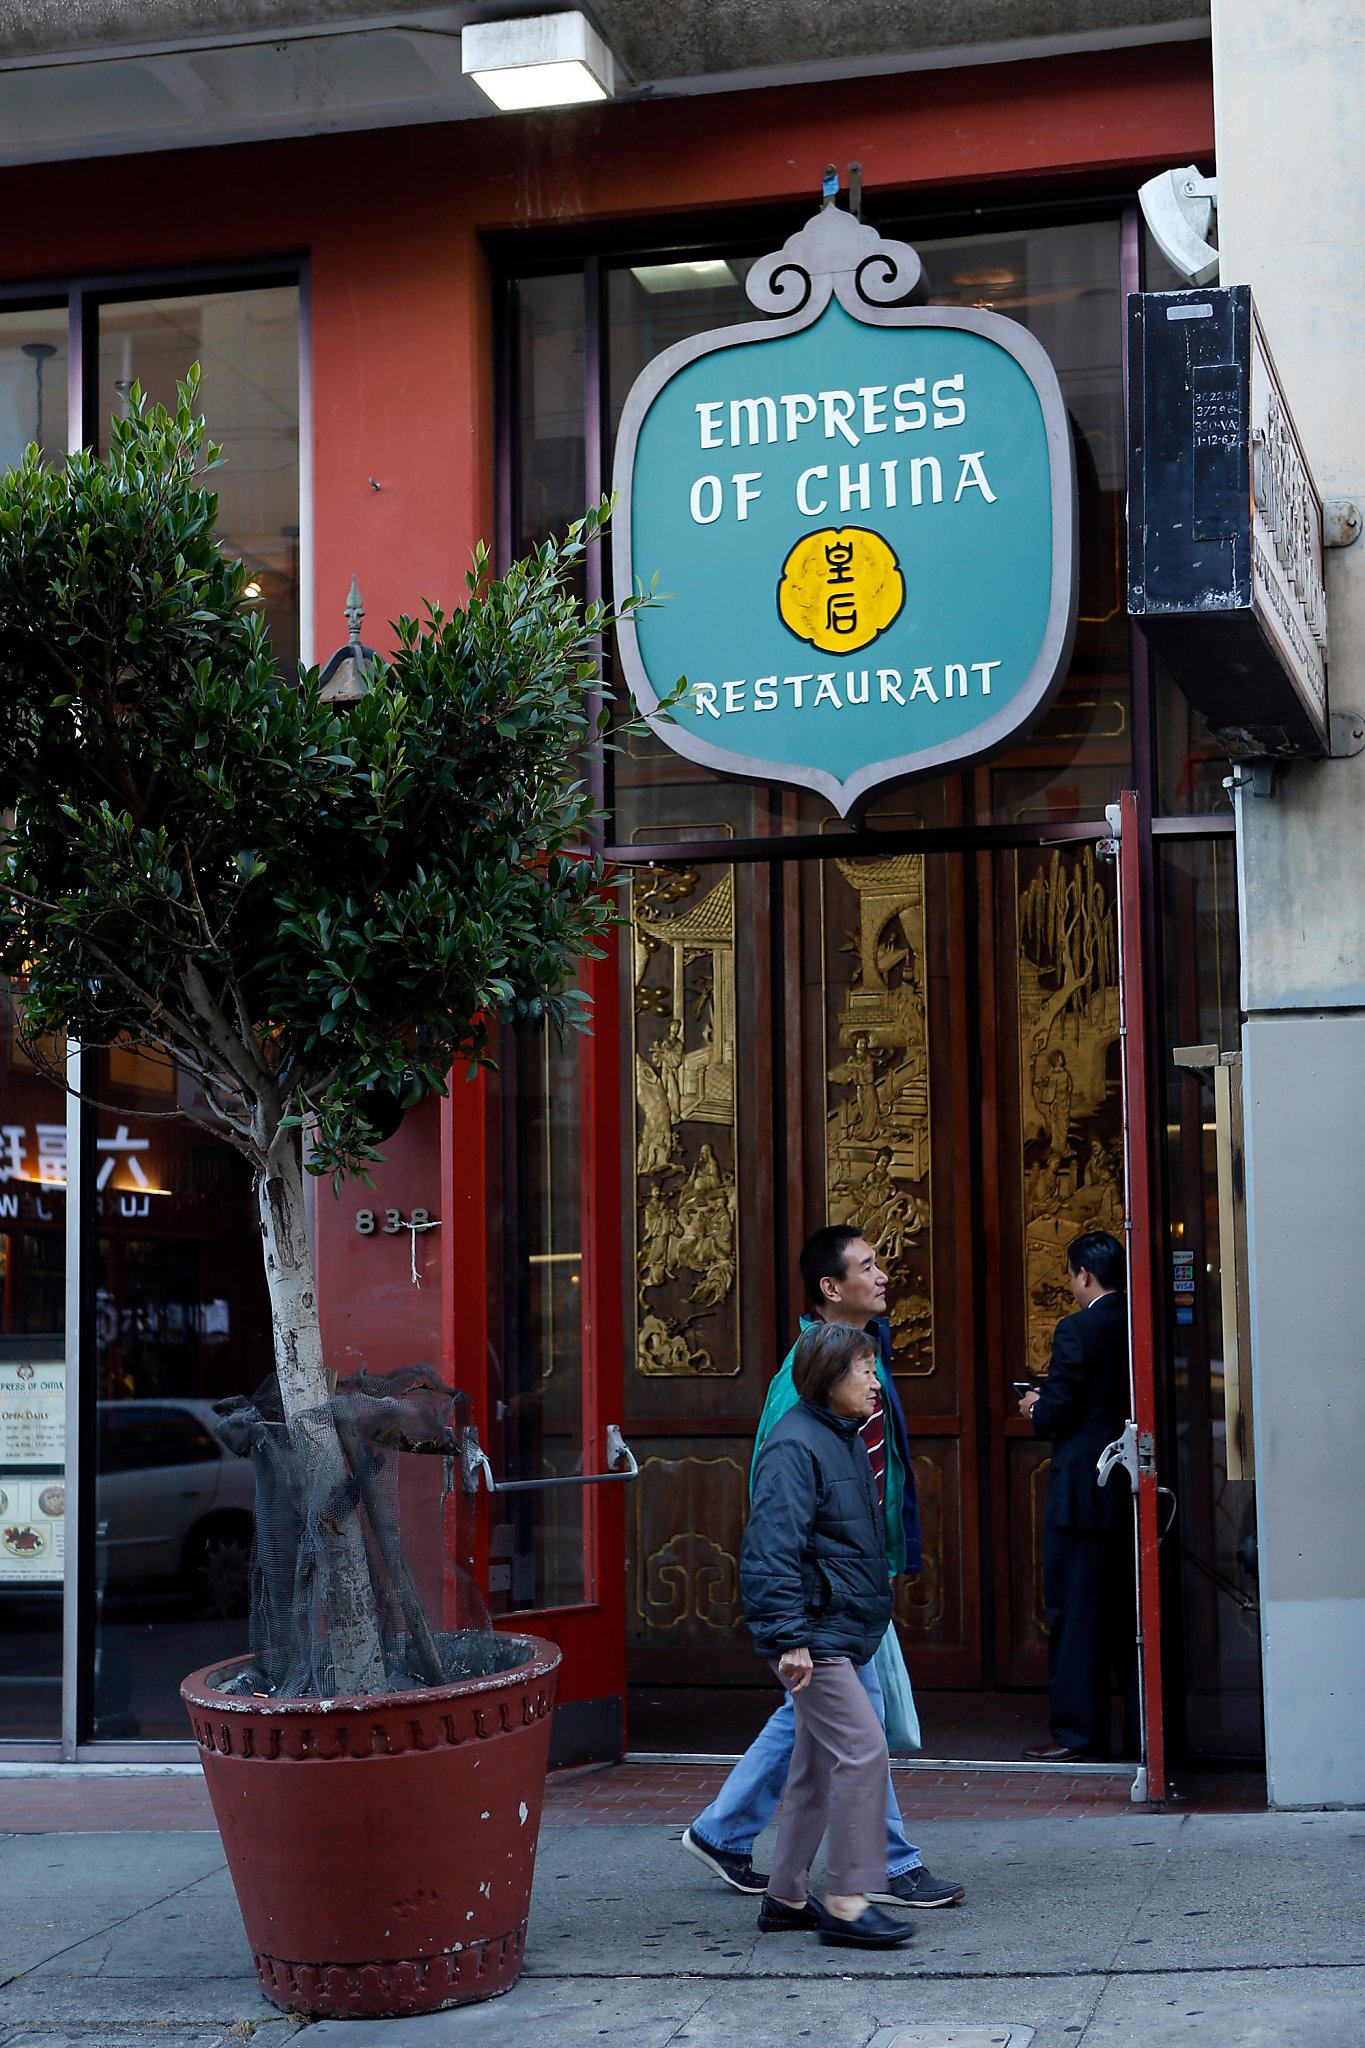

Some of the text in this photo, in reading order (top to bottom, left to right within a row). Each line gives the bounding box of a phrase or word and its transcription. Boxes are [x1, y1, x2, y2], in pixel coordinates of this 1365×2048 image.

[694, 373, 966, 450] EMPRESS
[689, 450, 998, 525] OF CHINA
[693, 660, 1002, 720] RESTAURANT
[355, 1207, 430, 1234] 838
[1175, 1282, 1193, 1290] VISA
[28, 1382, 37, 1391] OF
[40, 1381, 64, 1390] CHINA
